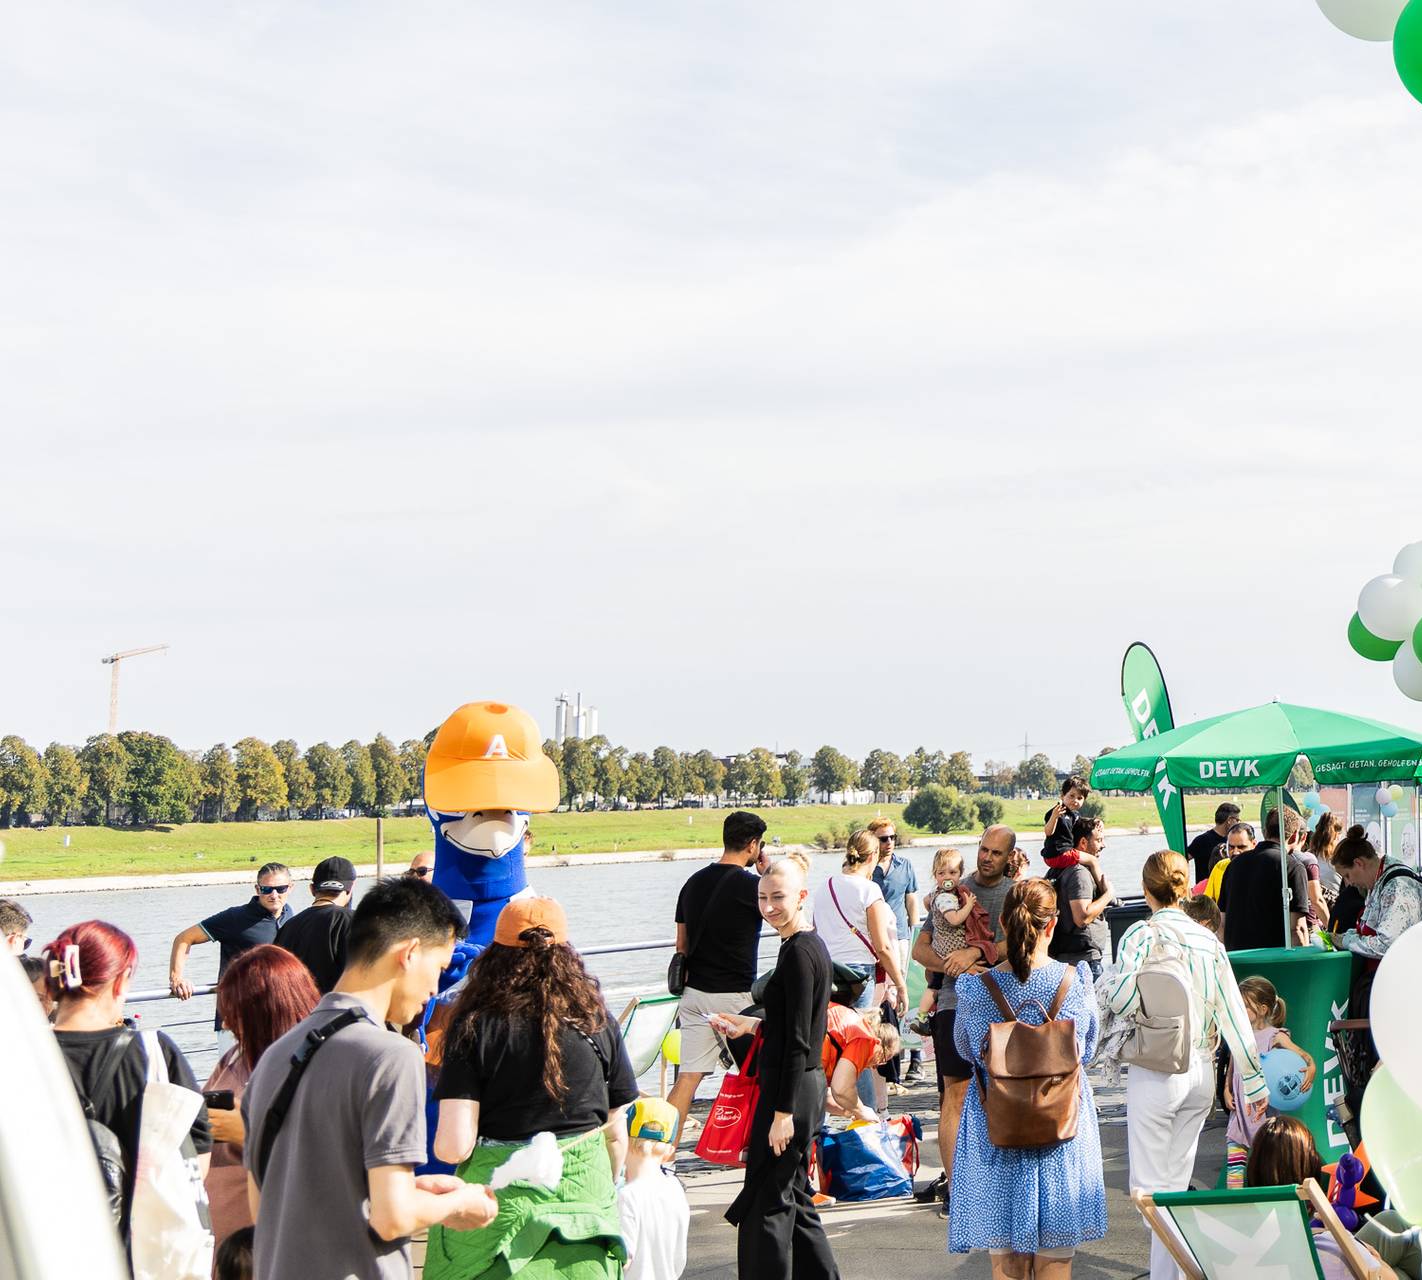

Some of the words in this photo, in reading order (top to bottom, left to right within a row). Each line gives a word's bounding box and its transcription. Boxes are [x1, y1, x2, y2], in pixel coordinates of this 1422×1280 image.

[485, 734, 509, 759] A
[1199, 759, 1260, 779] DEVK
[1315, 761, 1347, 773] GESAGT.
[1349, 759, 1377, 769] GETAN.
